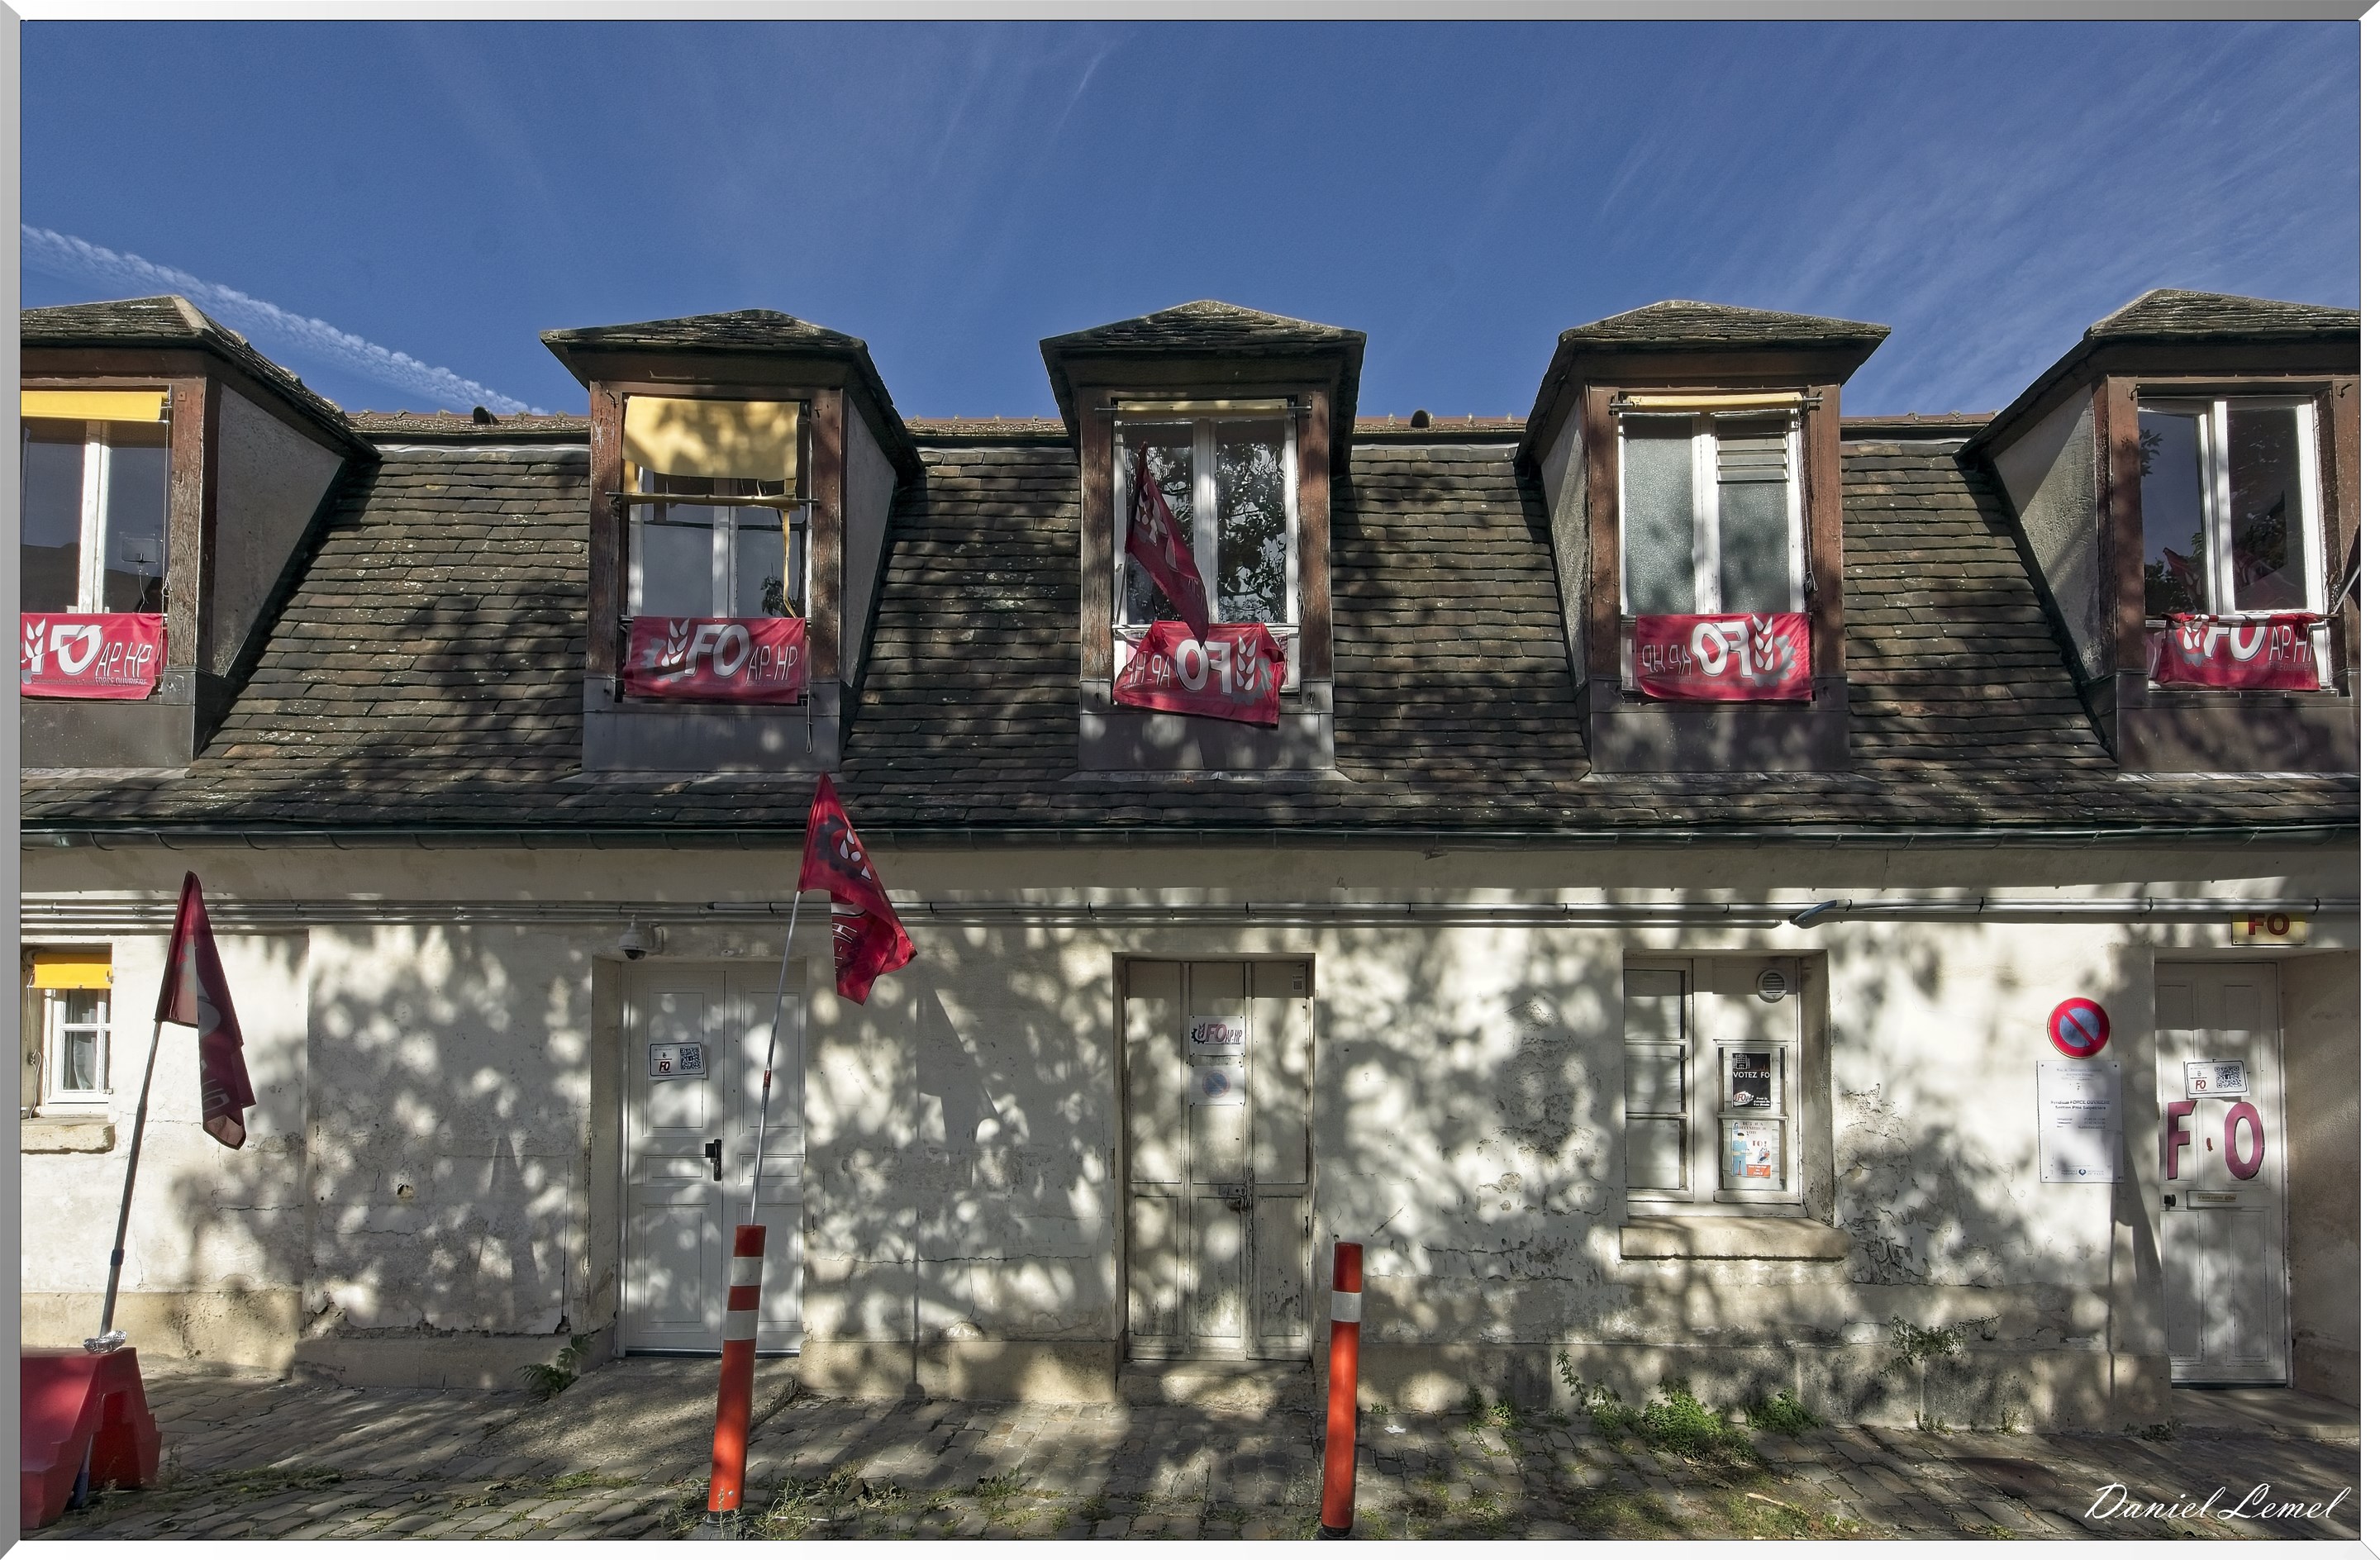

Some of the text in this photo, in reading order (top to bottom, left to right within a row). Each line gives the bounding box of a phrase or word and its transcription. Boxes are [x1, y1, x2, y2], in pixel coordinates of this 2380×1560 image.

[50, 625, 102, 676] FO
[684, 624, 751, 678] FO
[2248, 913, 2290, 936] FO
[659, 1061, 670, 1072] FO
[2195, 1080, 2206, 1092] FO
